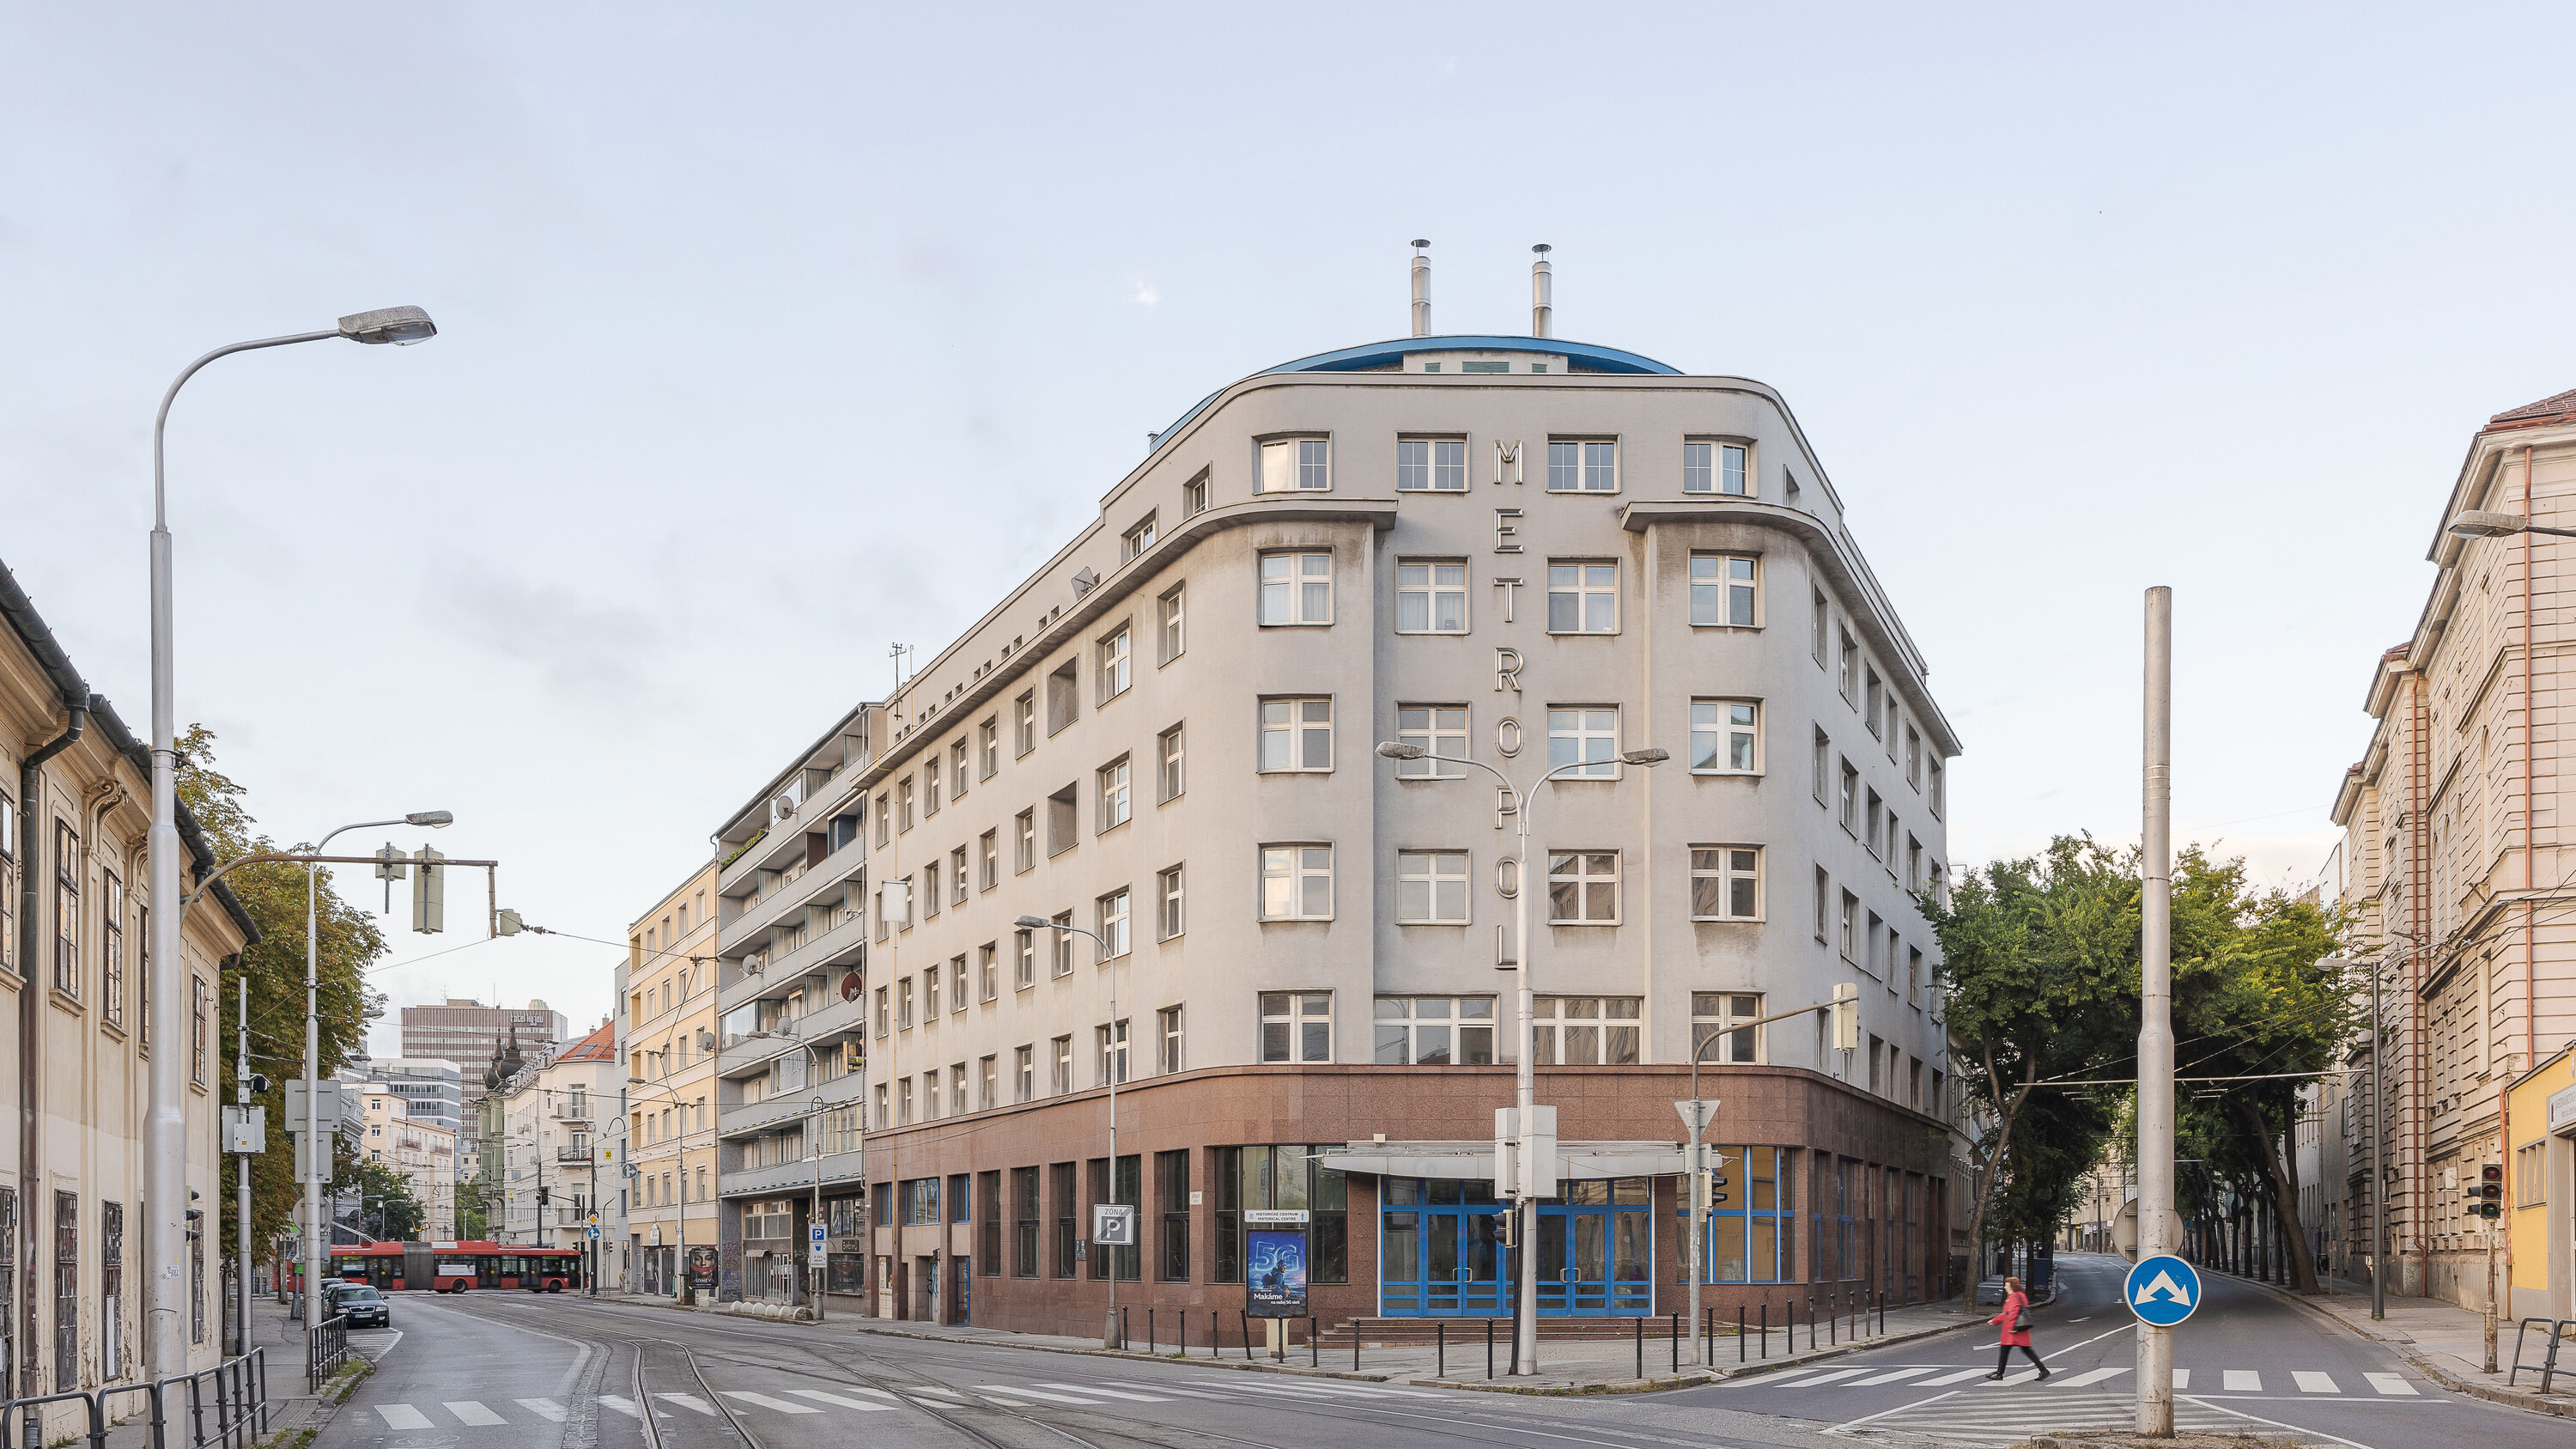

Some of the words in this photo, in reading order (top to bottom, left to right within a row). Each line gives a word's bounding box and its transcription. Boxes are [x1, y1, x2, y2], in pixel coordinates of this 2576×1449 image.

[1493, 439, 1525, 971] METROPOL
[815, 1230, 822, 1239] P
[1107, 1220, 1120, 1238] P
[1255, 1241, 1299, 1271] 5G
